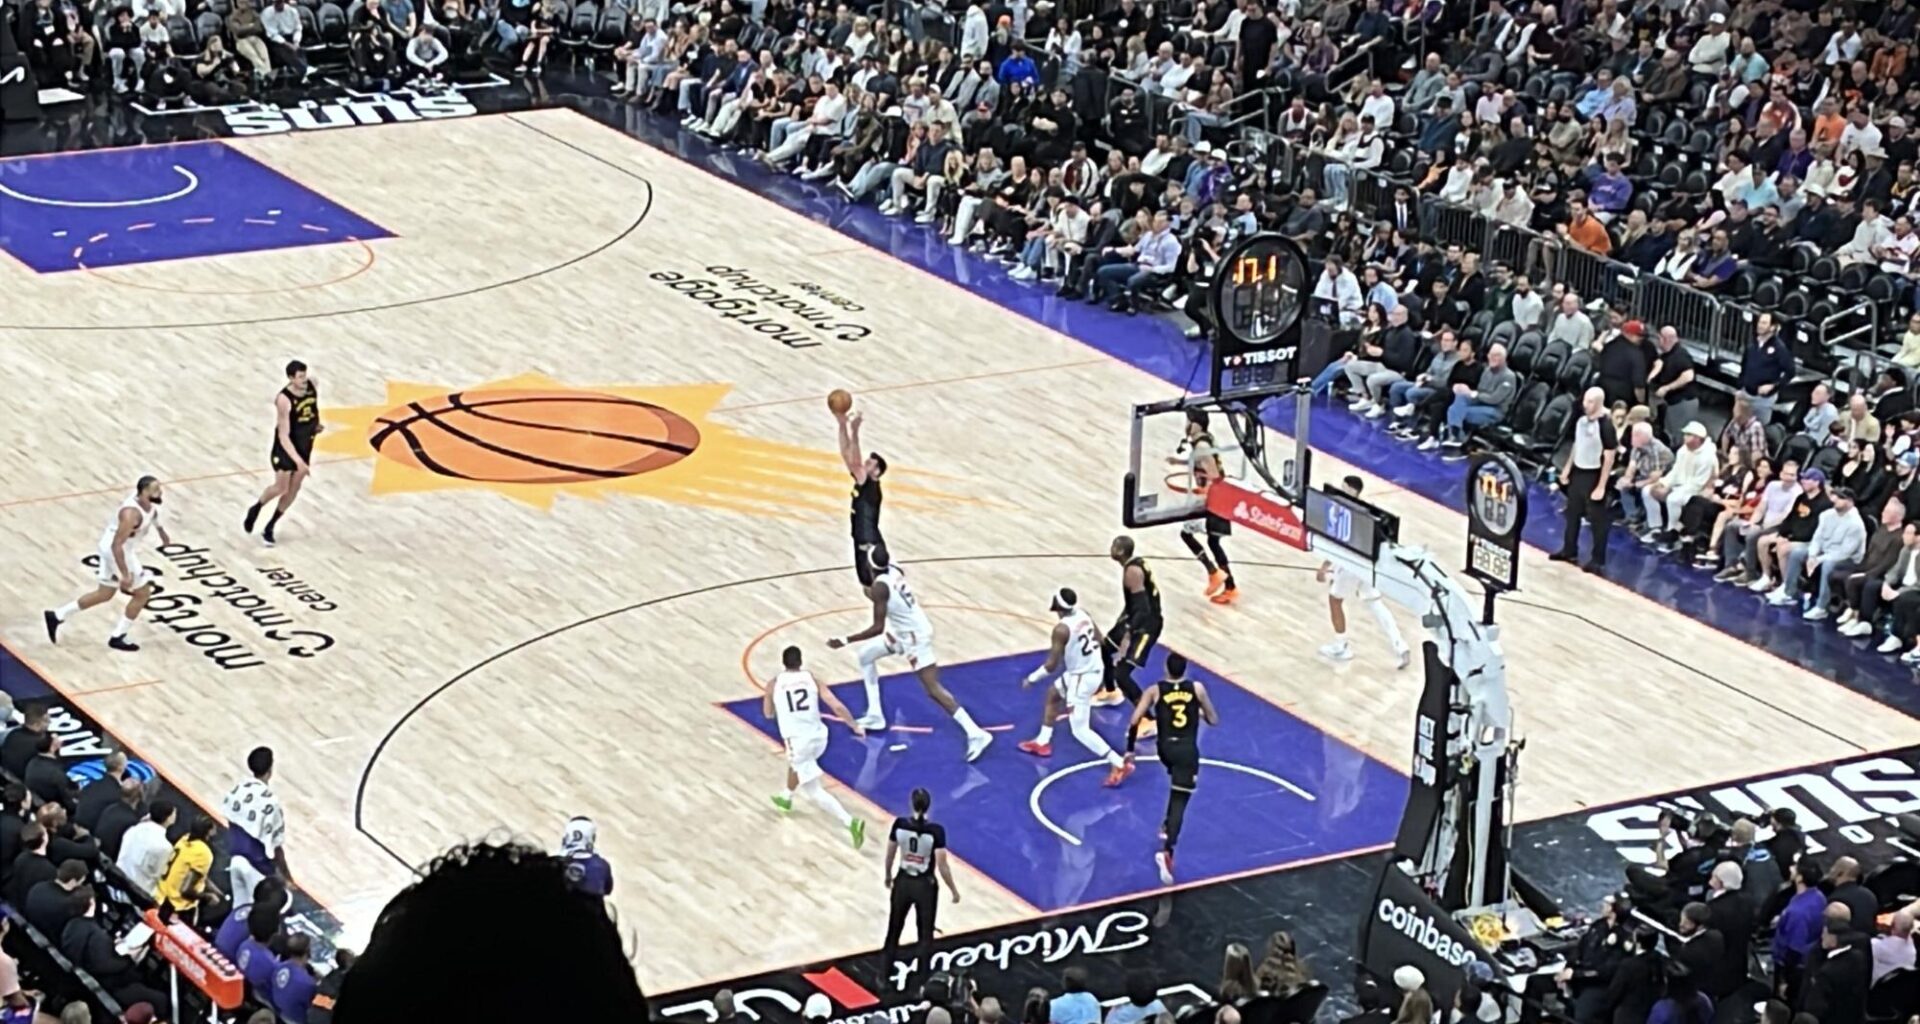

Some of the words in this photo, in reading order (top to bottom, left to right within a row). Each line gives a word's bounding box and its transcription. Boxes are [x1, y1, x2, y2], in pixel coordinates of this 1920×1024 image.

[649, 271, 822, 349] mortgage
[706, 265, 834, 322] matchup
[1243, 346, 1298, 366] TISSOT
[81, 554, 266, 670] mortg
[156, 543, 294, 627] matchup
[256, 567, 338, 612] center
[785, 688, 810, 713] 12
[1171, 703, 1188, 728] 3
[889, 911, 1150, 991] Michel
